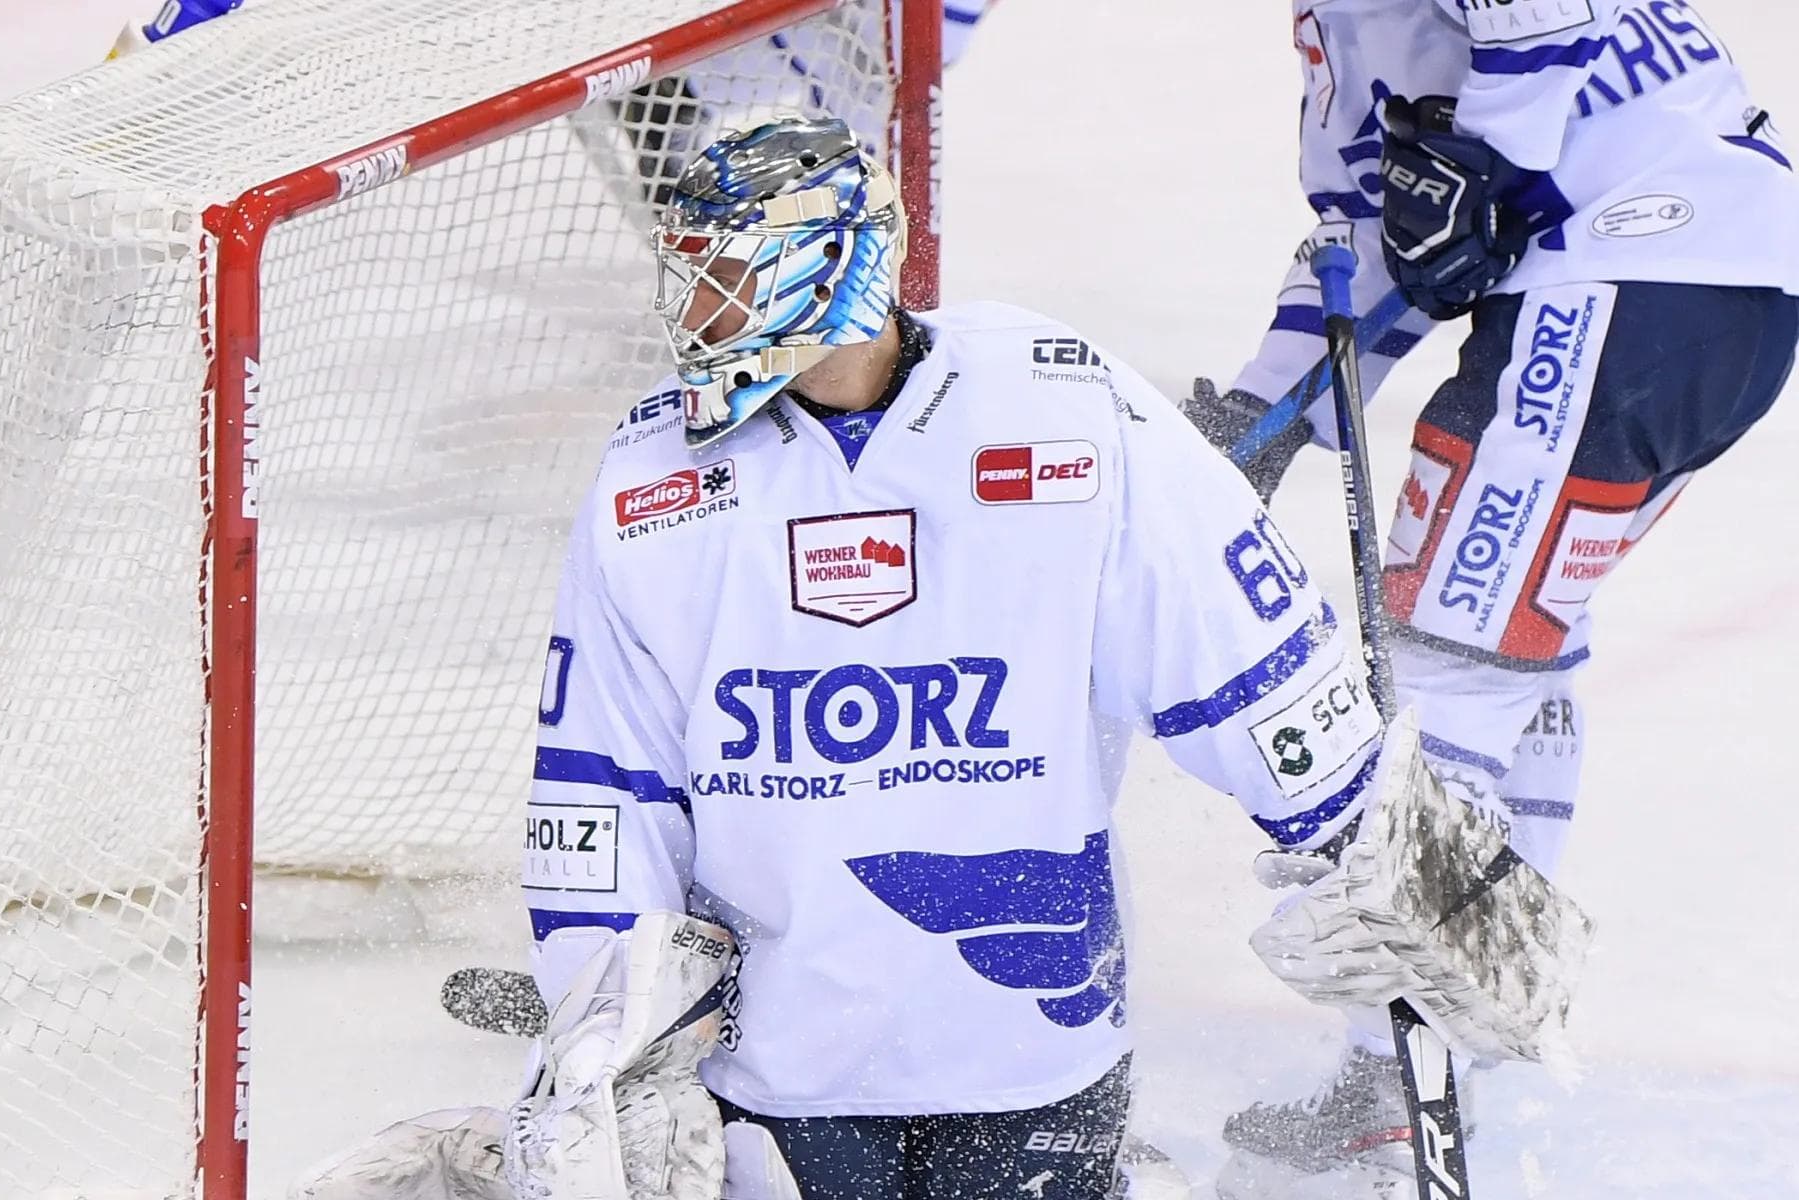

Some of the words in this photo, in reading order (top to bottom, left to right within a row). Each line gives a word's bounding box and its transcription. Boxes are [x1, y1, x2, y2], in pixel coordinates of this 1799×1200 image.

[1514, 303, 1579, 436] STORZ
[1037, 456, 1094, 481] DEL
[617, 496, 740, 542] VENTILATOREN
[624, 483, 694, 516] Helios
[804, 545, 857, 565] WERNER
[1439, 483, 1524, 614] STORZ
[805, 563, 872, 584] WOHNBAU
[714, 656, 1011, 765] STORZ
[690, 770, 755, 798] KARL
[760, 773, 846, 801] STORZ
[878, 756, 1046, 791] ENDOSKOPE
